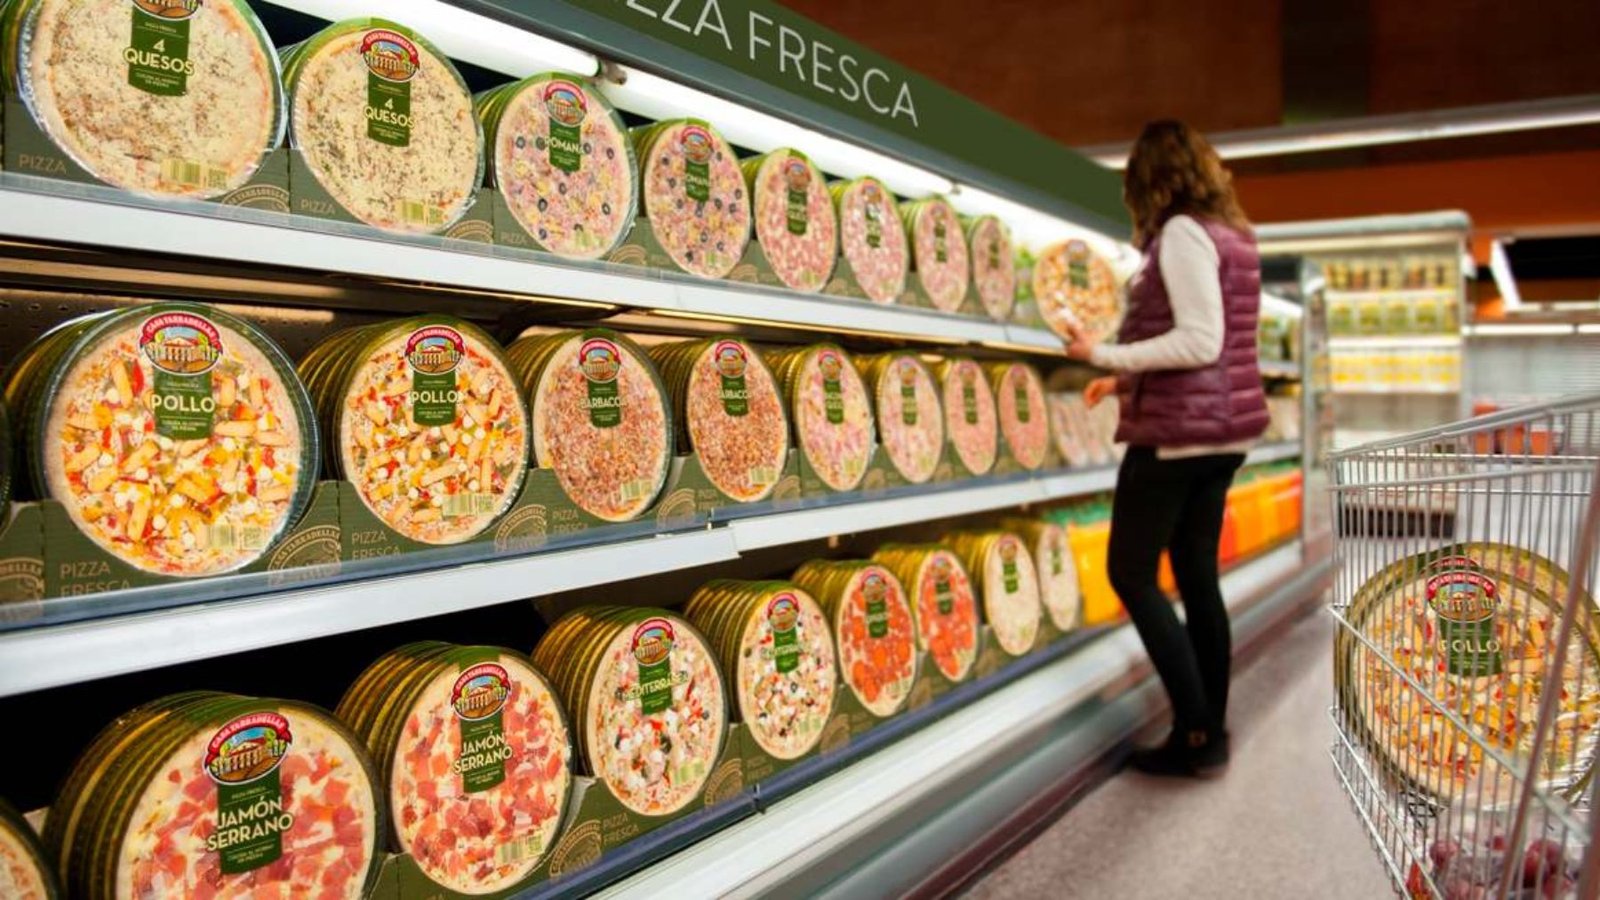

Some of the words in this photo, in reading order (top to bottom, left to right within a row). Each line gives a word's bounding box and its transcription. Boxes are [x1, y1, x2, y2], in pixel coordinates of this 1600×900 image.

[153, 39, 165, 52] 4
[124, 47, 195, 75] QUESOS
[749, 10, 918, 127] FRESCA
[385, 97, 394, 110] 4
[364, 106, 415, 129] QUESOS
[19, 153, 68, 174] PIZZA
[151, 394, 216, 413] POLLO
[411, 389, 458, 404] POLLO
[352, 529, 388, 545] PIZZA
[61, 561, 111, 579] PIZZA
[461, 730, 505, 757] JAMÓN
[454, 746, 513, 774] SERRANO
[217, 795, 283, 829] JAMÓN
[207, 812, 294, 851] SERRANO
